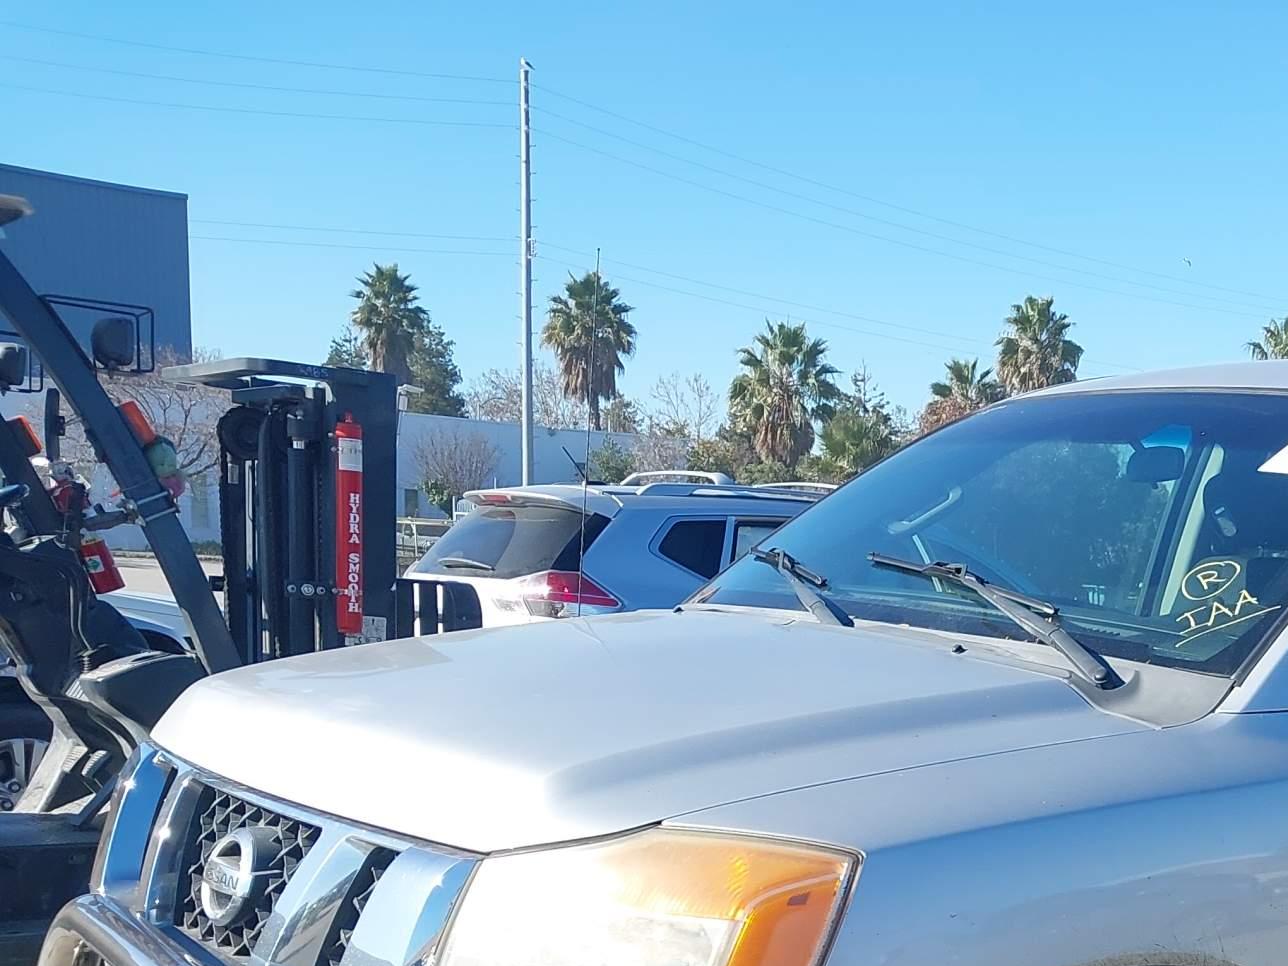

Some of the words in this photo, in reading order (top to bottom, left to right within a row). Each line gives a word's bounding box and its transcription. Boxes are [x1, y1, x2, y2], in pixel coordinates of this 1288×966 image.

[349, 493, 361, 544] HYDRA
[348, 553, 361, 612] SMOOTH
[1175, 589, 1259, 635] IAA
